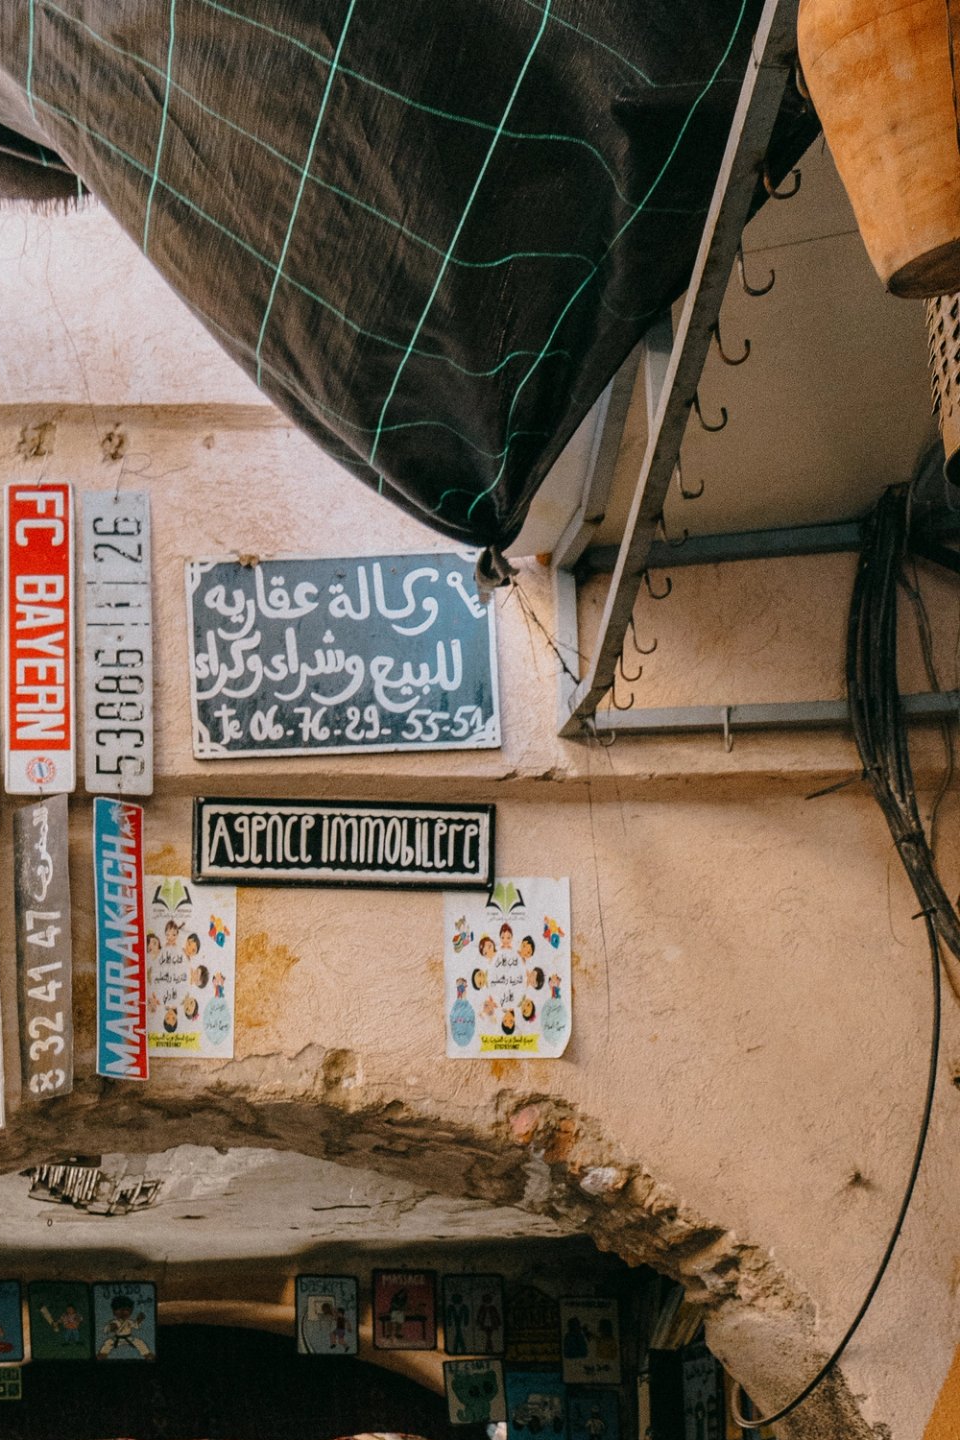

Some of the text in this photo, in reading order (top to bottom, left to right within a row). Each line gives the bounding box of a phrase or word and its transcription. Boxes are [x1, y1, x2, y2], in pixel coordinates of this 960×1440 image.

[14, 490, 66, 548] FC
[328, 561, 440, 636] وكالة
[15, 573, 67, 742] BAYERN
[369, 637, 462, 713] للبيع
[26, 908, 63, 947] 47
[101, 833, 141, 1078] MARRAKECH
[27, 959, 64, 1003] 41
[27, 1011, 64, 1054] 32
